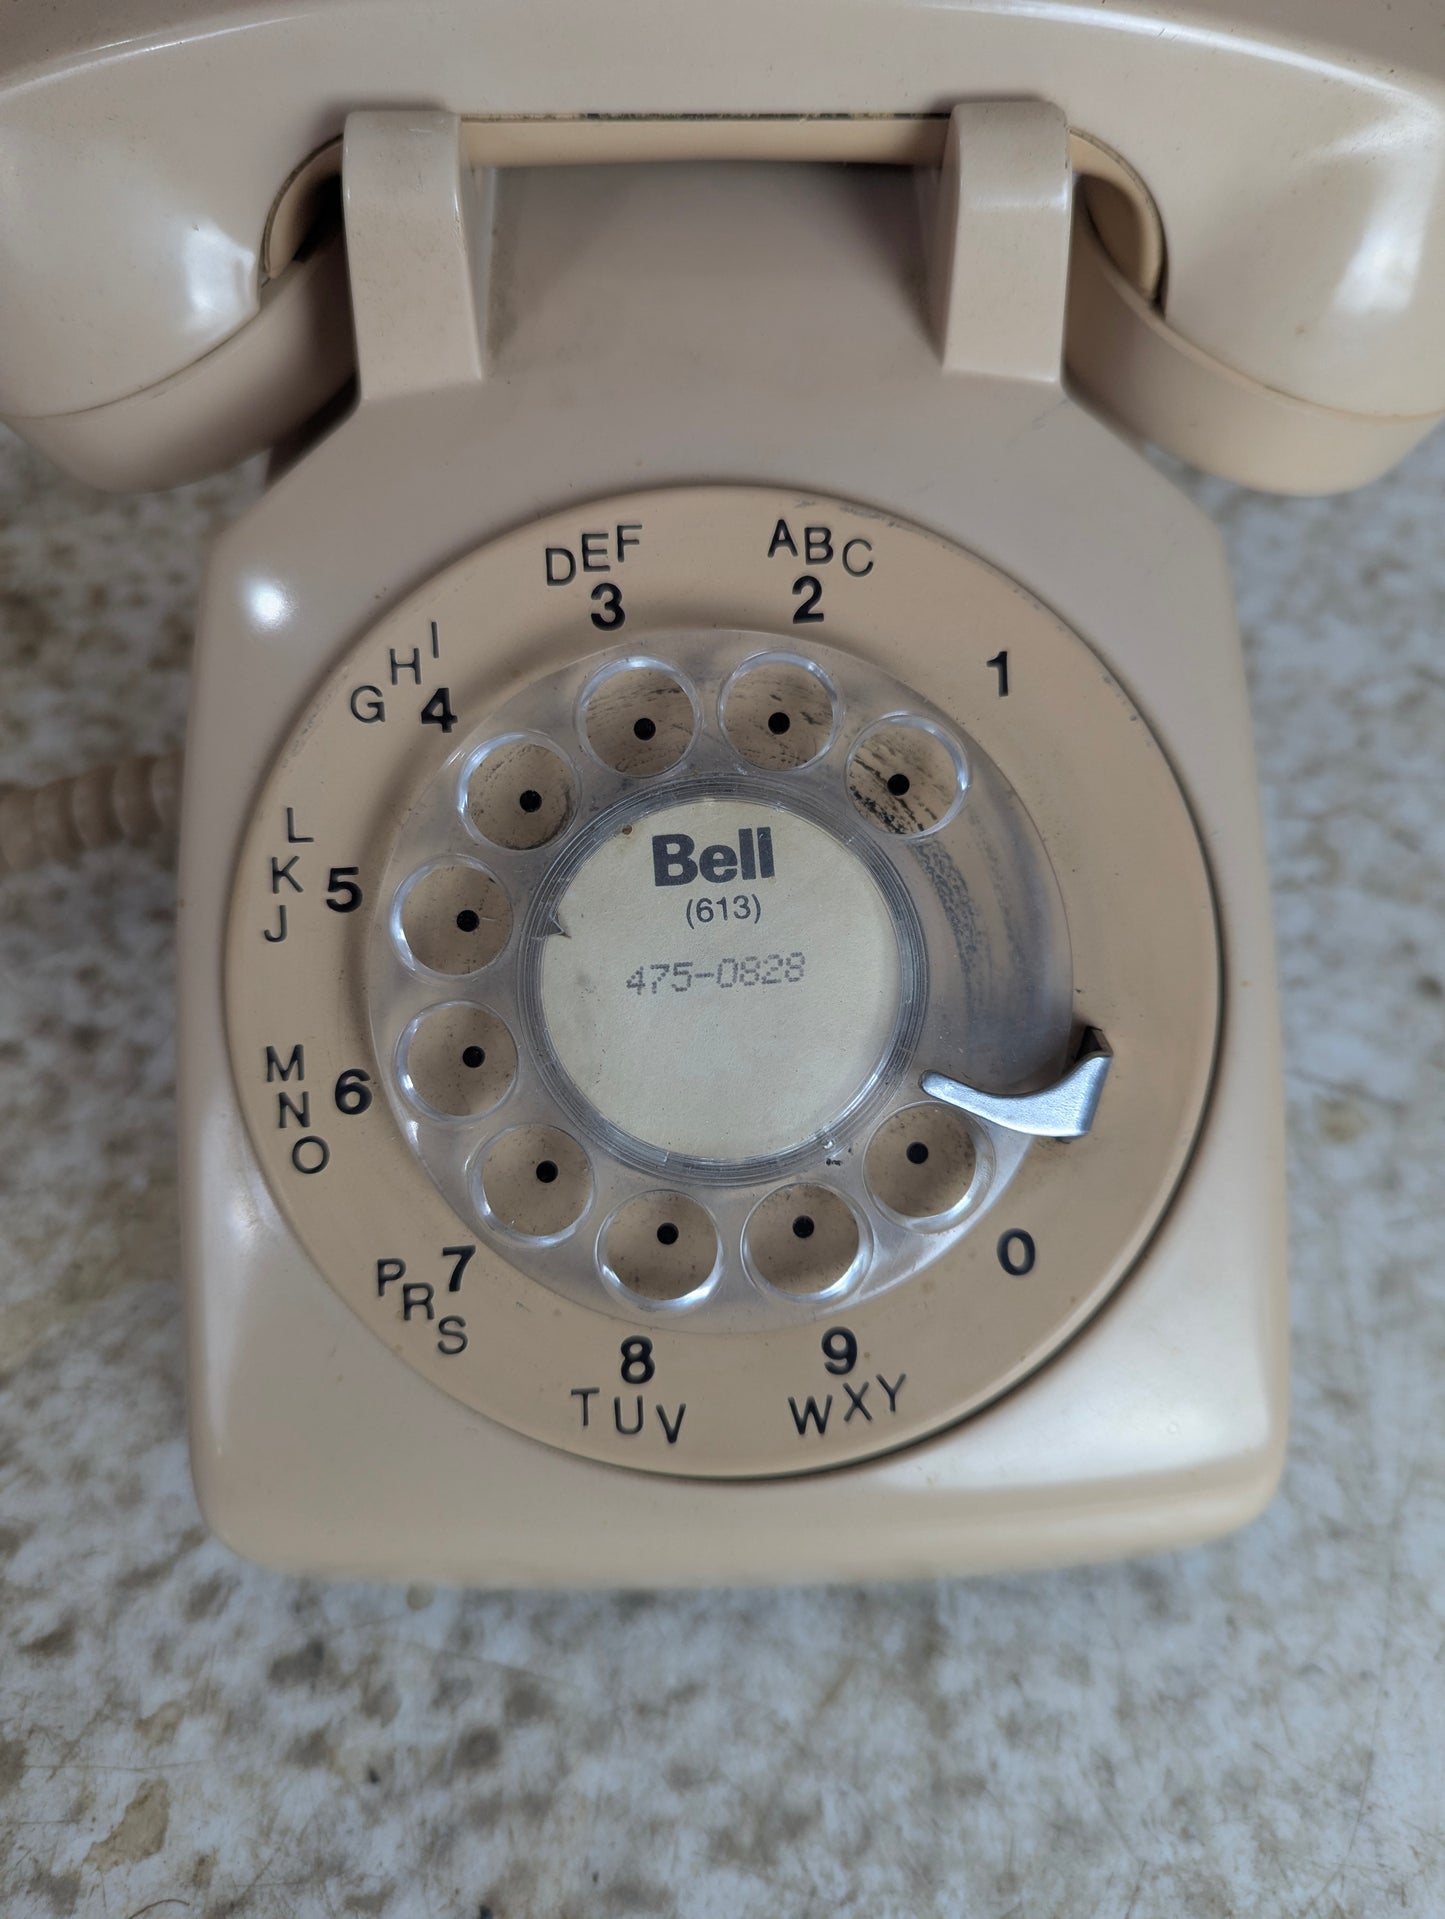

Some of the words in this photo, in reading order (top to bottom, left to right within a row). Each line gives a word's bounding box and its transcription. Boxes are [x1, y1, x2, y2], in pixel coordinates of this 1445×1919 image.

[544, 524, 643, 587] DEF
[767, 518, 877, 578] ABC
[590, 582, 626, 632] 3
[791, 575, 825, 625] 2
[985, 650, 1010, 698] 1
[419, 687, 458, 734] 4
[652, 826, 776, 887] Bell
[325, 866, 364, 914] 5
[685, 893, 762, 930] (613)
[626, 952, 806, 995] 475-0828
[334, 1068, 373, 1116] 6
[441, 1246, 476, 1293] 7
[996, 1228, 1036, 1277] 0
[620, 1335, 656, 1385] 8
[821, 1326, 858, 1376] 9
[570, 1387, 687, 1444] TUV
[787, 1373, 906, 1436] WXY
